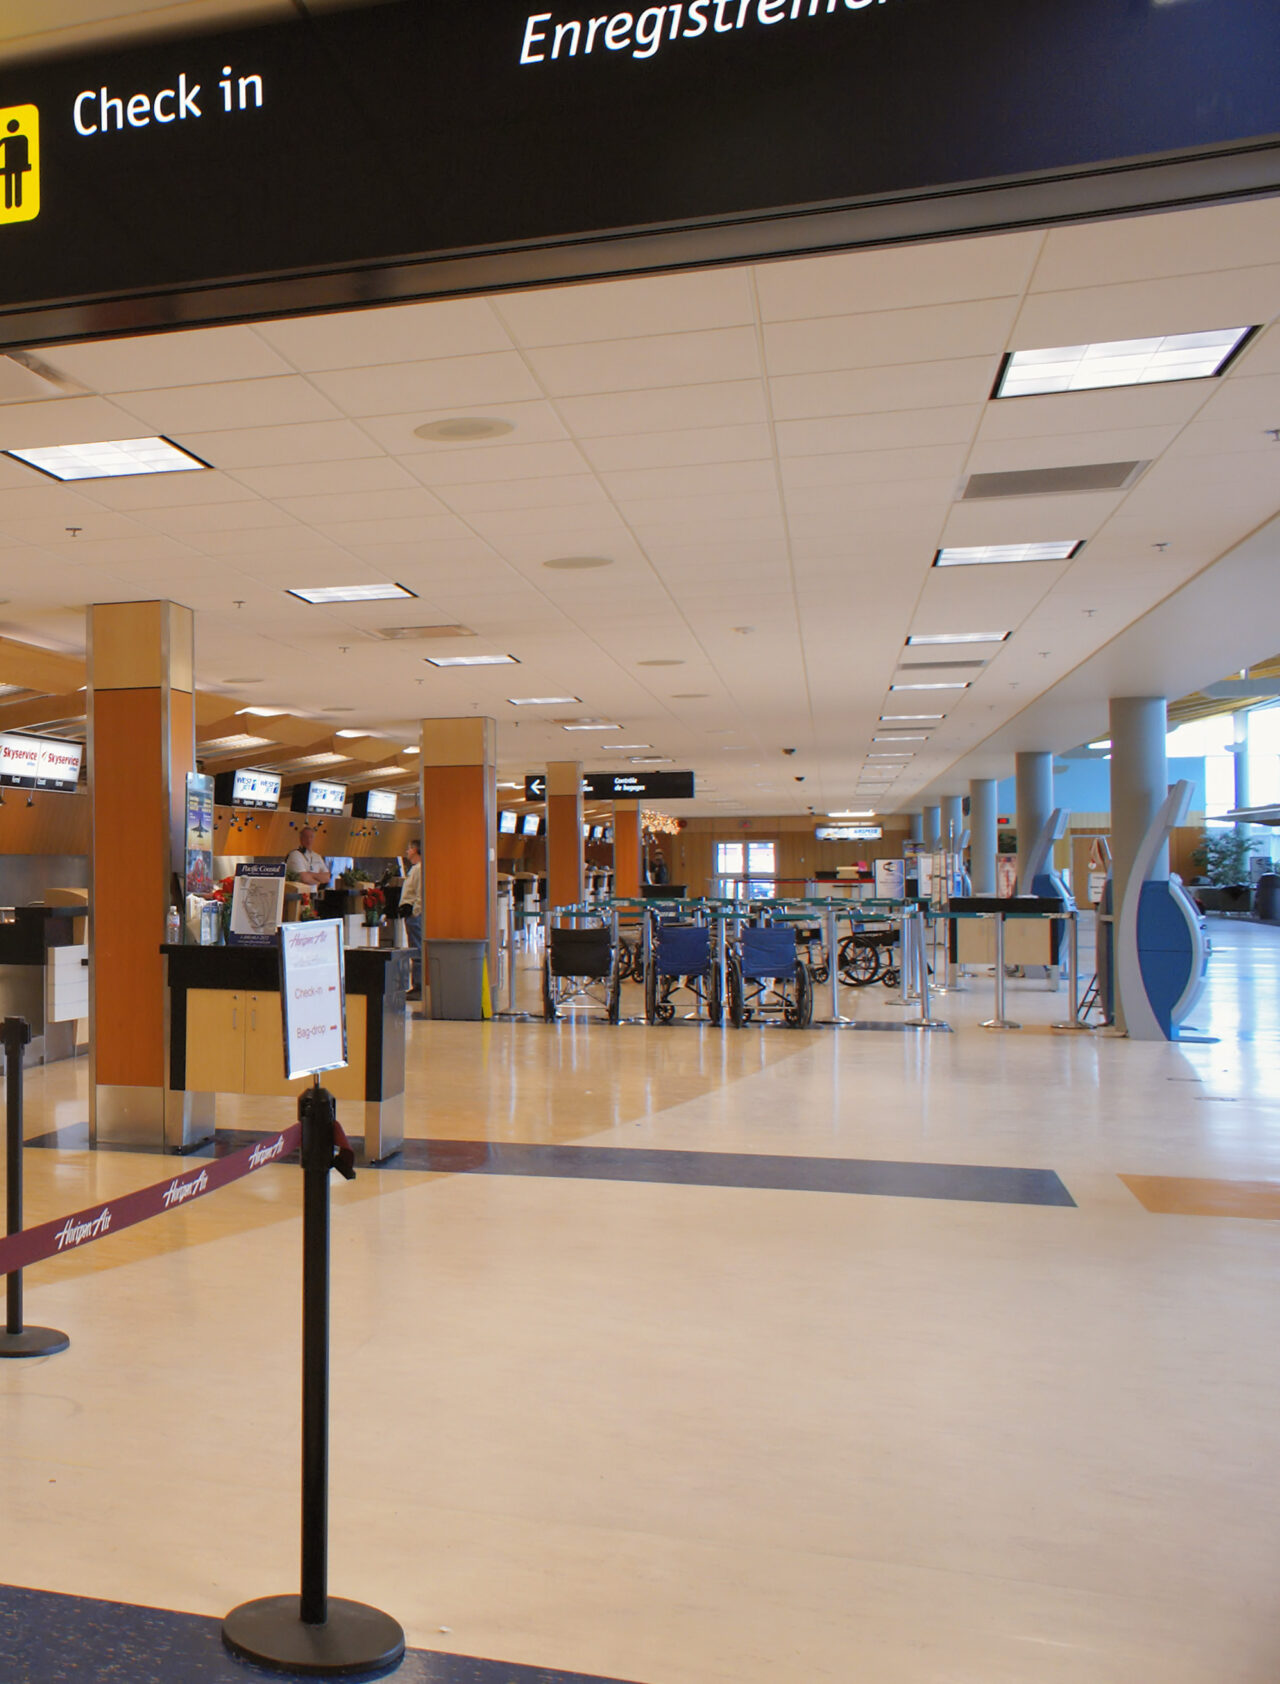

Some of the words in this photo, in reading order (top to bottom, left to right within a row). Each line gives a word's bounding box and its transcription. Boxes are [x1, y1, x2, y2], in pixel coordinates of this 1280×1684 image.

[519, 0, 886, 65] Enregistre
[73, 73, 202, 136] Check
[219, 65, 263, 112] in
[3, 747, 38, 761] Skyservice
[47, 753, 79, 767] Skyservice
[297, 1023, 326, 1040] Bag-drop
[163, 1178, 192, 1208] Horizon
[192, 1169, 208, 1196] Air
[54, 1220, 93, 1250] Horizon
[92, 1207, 112, 1237] Air
